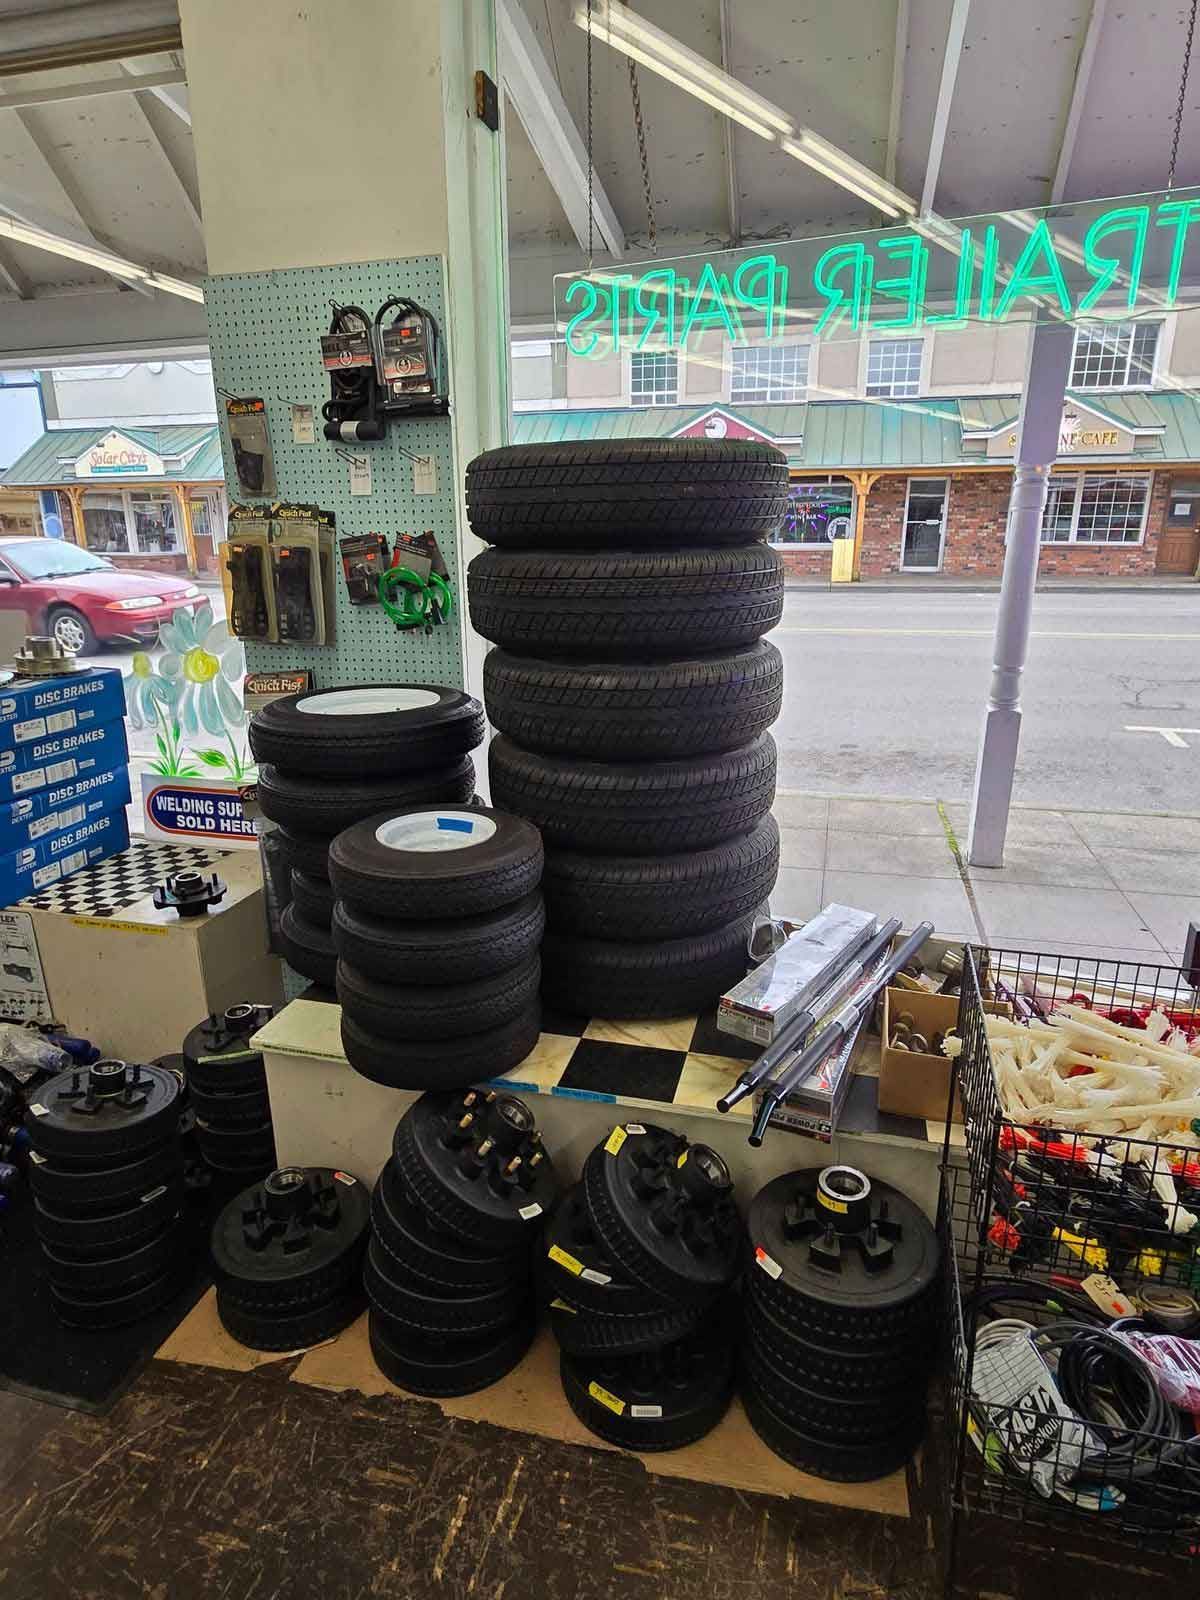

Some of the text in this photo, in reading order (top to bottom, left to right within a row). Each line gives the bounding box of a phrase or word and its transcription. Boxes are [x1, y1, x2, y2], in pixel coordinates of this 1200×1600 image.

[1081, 431, 1118, 446] CAFE
[34, 690, 61, 706] DISC
[63, 680, 105, 699] BRAKES
[33, 740, 60, 757] DISC
[62, 729, 105, 749] BRAKES
[48, 786, 74, 803] DISC
[75, 772, 114, 794] BRAKES
[156, 795, 214, 815] WELDING
[176, 814, 216, 830] SOLD
[50, 833, 74, 852] DISC
[75, 817, 111, 841] BRAKES
[15, 860, 37, 875] DEXTER
